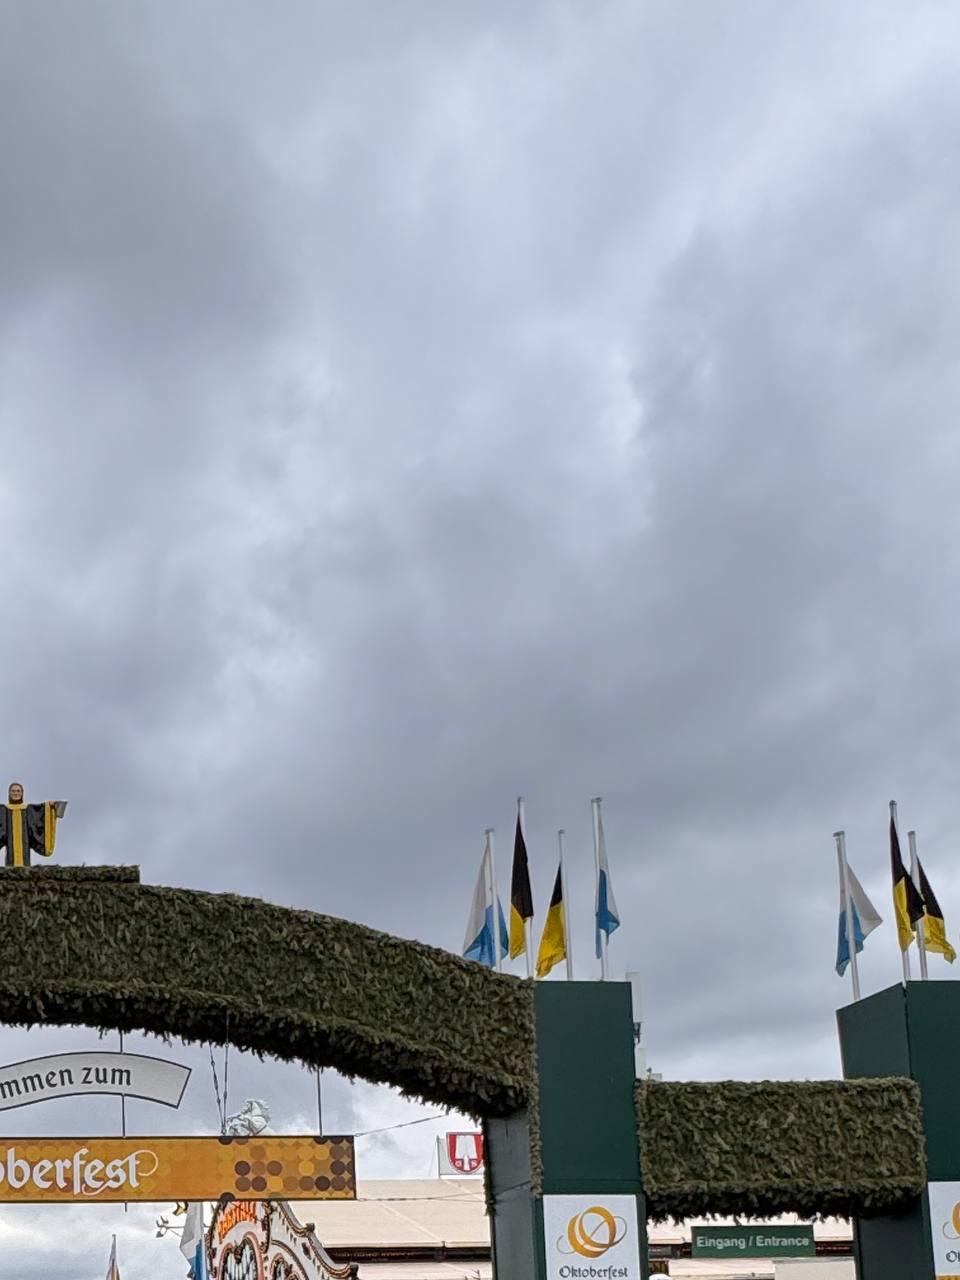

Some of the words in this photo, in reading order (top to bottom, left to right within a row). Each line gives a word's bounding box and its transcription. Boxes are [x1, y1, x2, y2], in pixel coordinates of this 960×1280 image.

[80, 1066, 132, 1087] zum
[696, 1236, 746, 1250] Eingang
[749, 1236, 754, 1247] /
[756, 1235, 810, 1247] Entrance
[559, 1265, 628, 1280] Oktoberfest
